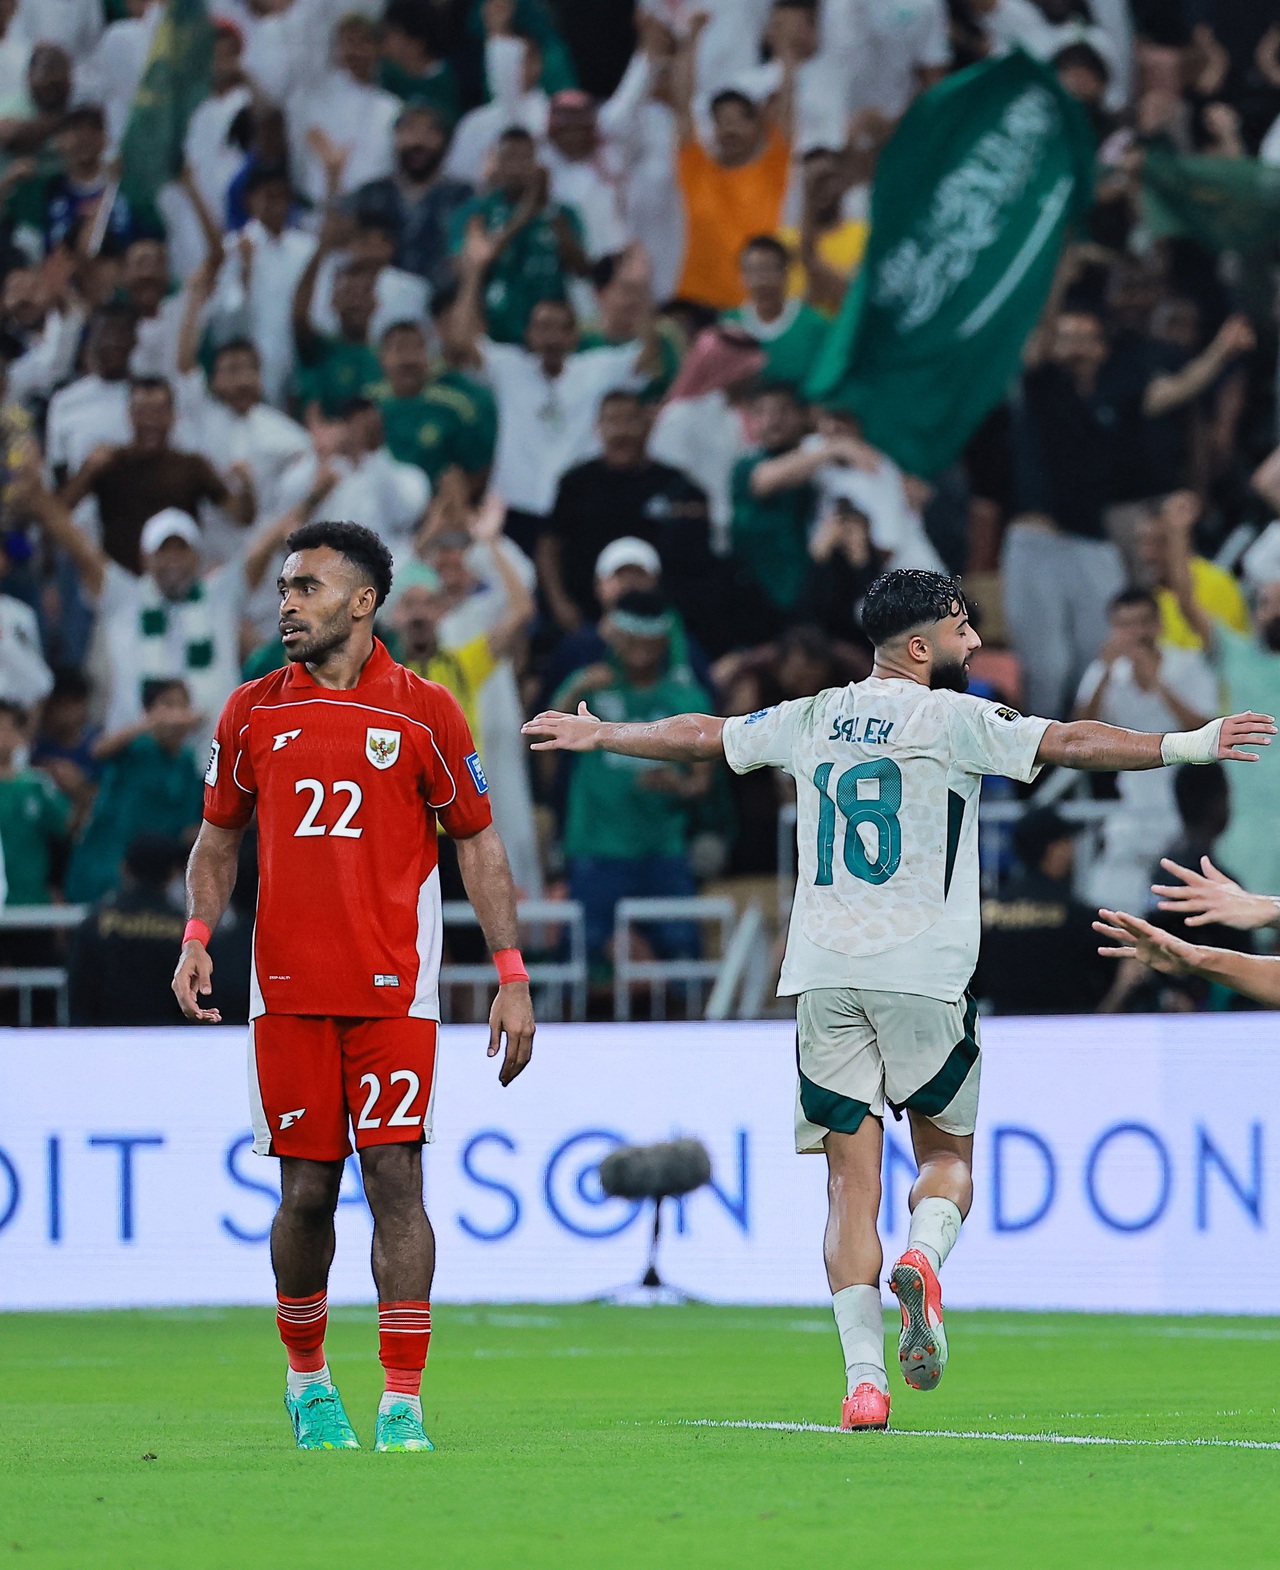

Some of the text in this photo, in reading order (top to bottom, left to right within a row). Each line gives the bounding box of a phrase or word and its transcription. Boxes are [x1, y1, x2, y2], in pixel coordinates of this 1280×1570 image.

[828, 715, 894, 744] SALEH
[293, 778, 363, 838] 22
[813, 757, 902, 886] 18
[357, 1069, 422, 1129] 22
[0, 1134, 165, 1242] IT
[221, 1130, 750, 1242] SSON
